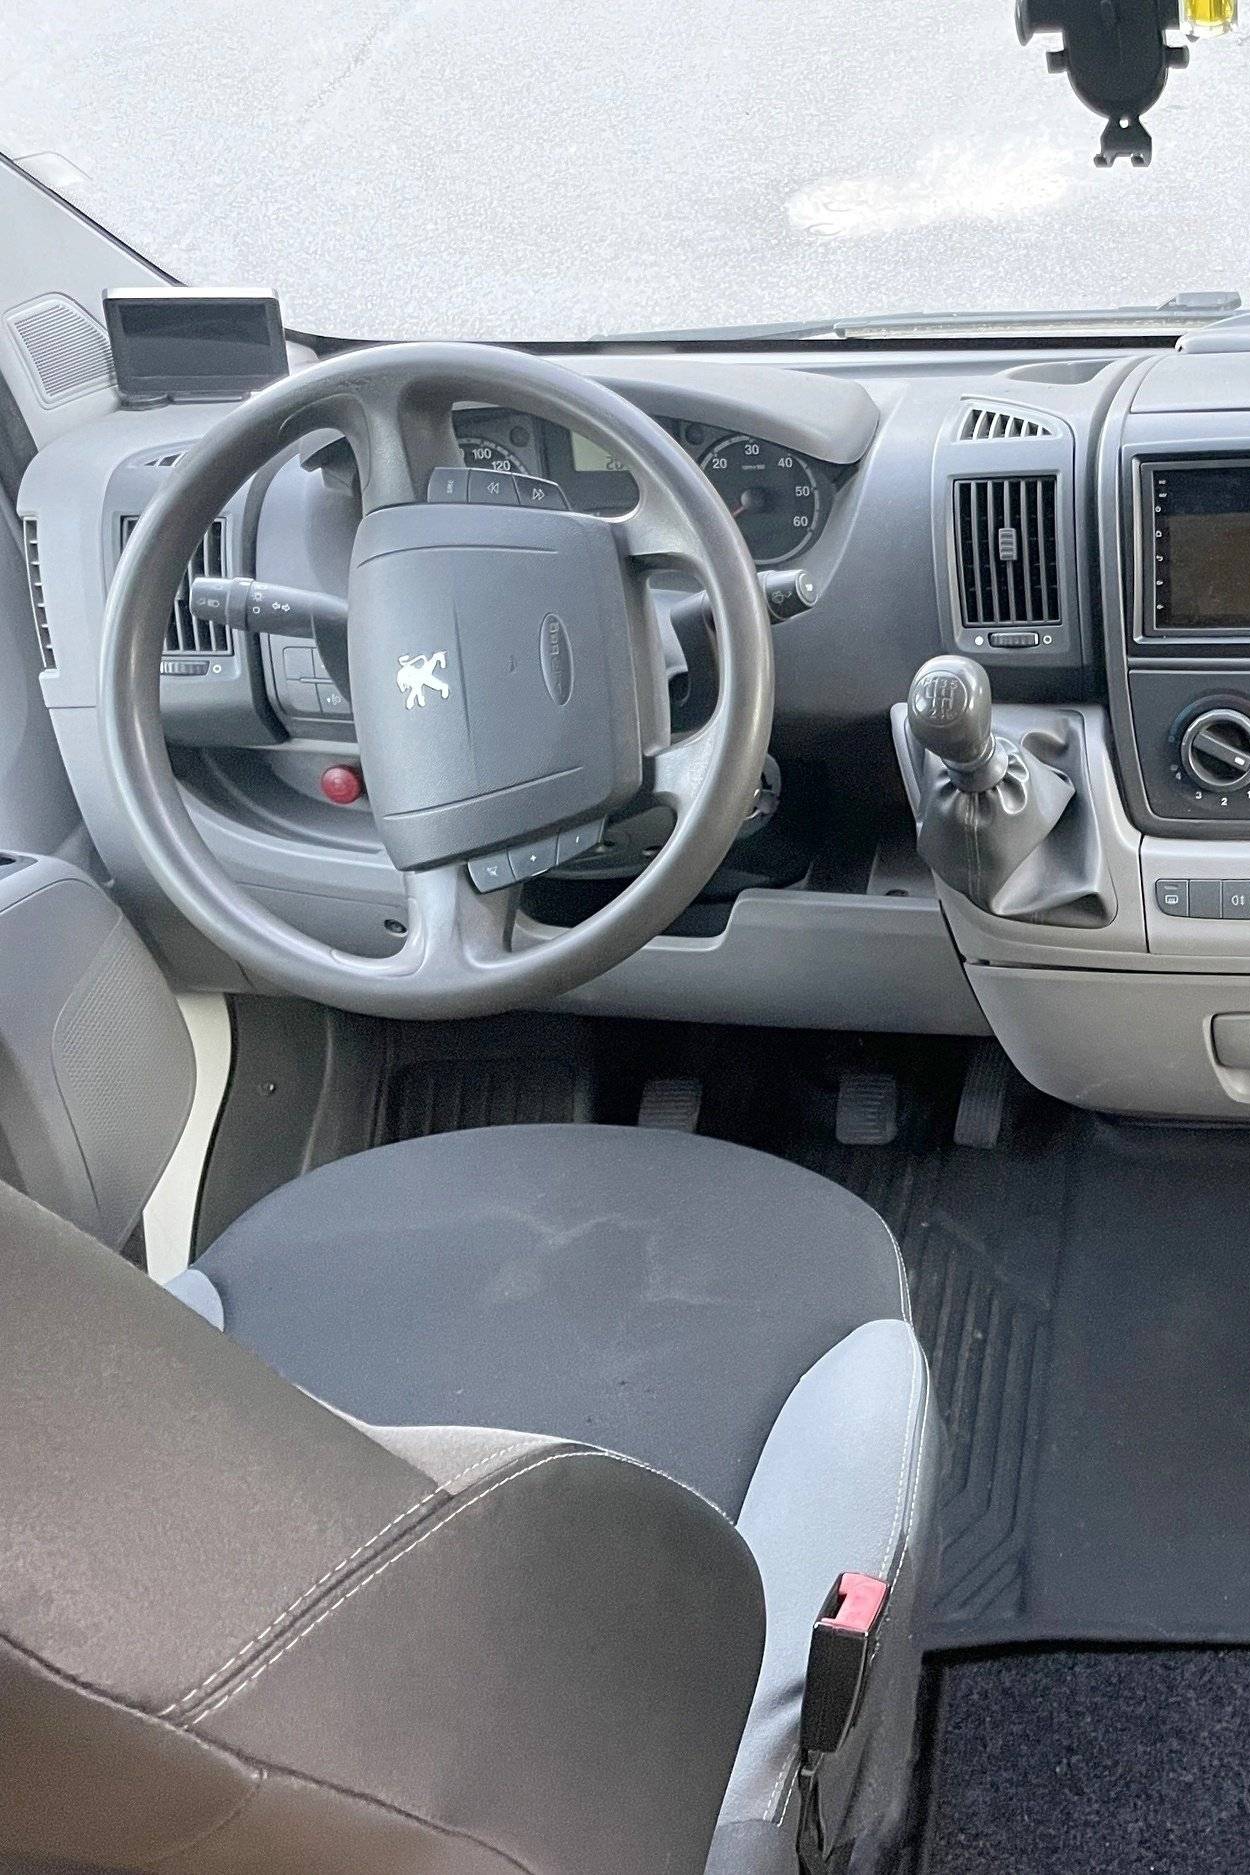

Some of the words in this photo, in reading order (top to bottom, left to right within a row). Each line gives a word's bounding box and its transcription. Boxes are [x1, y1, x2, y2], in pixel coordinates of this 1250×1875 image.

[472, 448, 492, 460] 100
[744, 444, 760, 455] 30
[491, 460, 511, 471] 120
[712, 458, 728, 469] 20
[778, 457, 793, 468] 40
[795, 486, 810, 497] 50
[793, 516, 808, 527] 60
[1195, 791, 1203, 800] 3
[1221, 797, 1228, 806] 2
